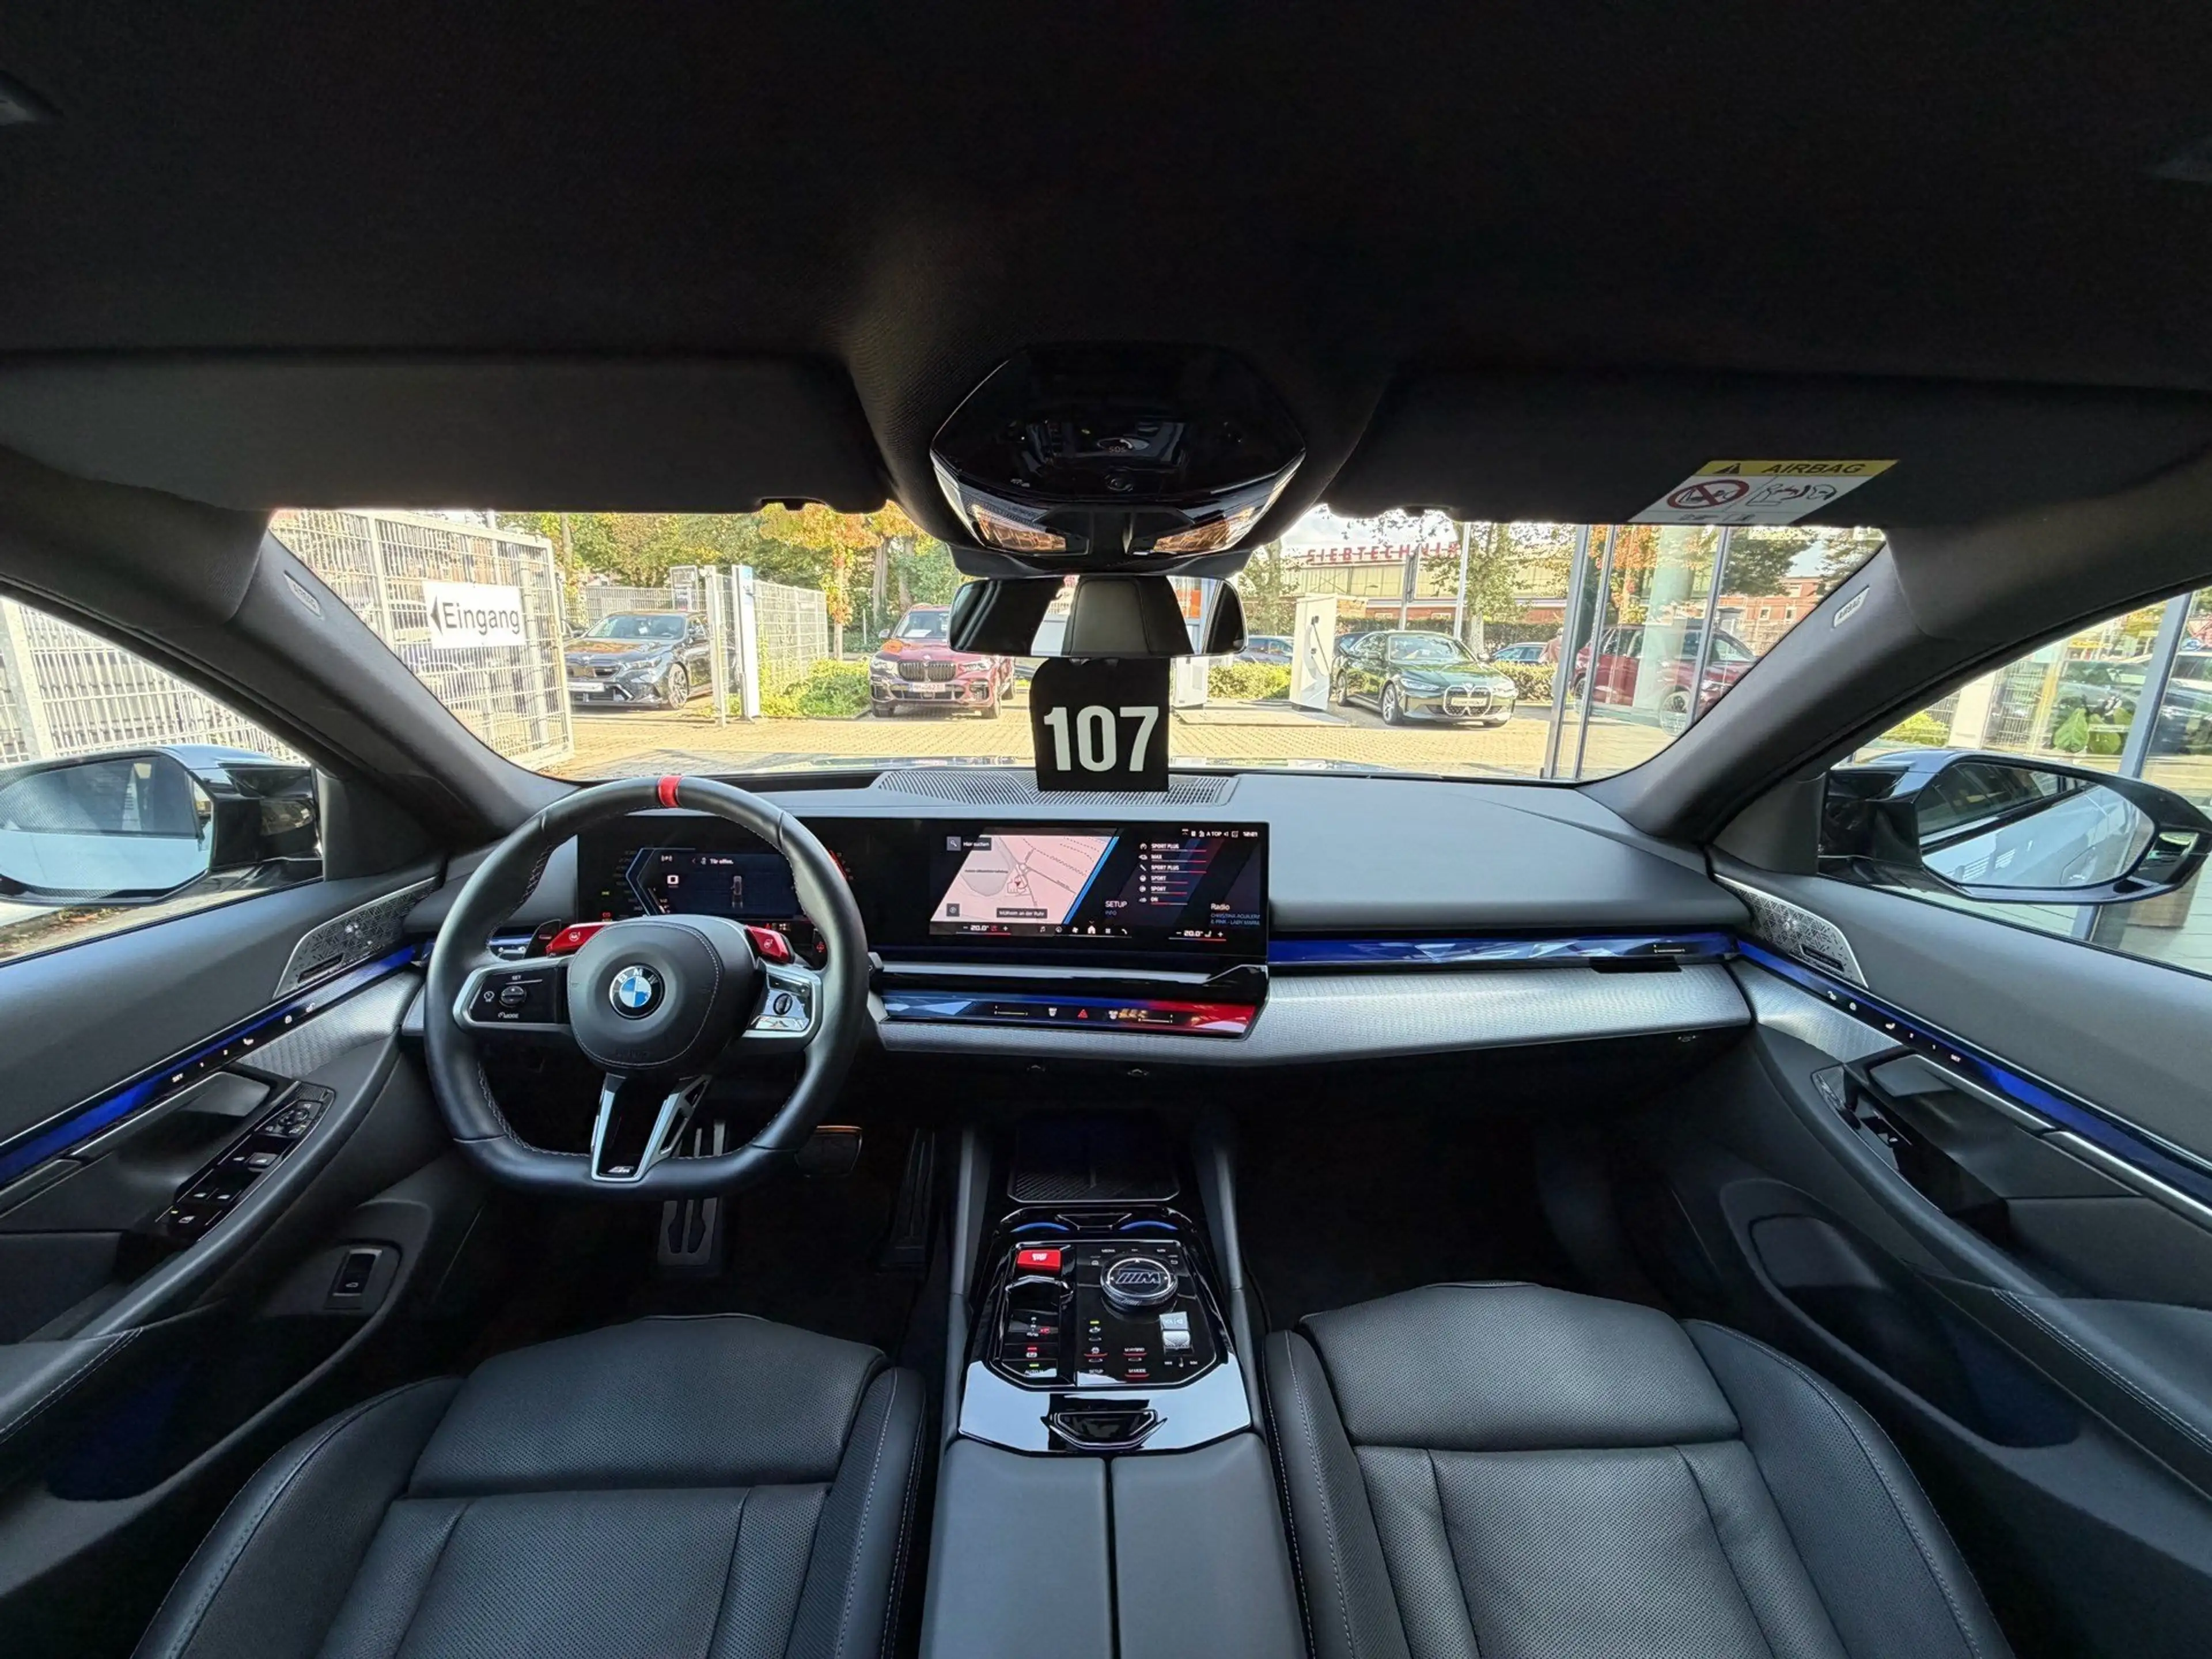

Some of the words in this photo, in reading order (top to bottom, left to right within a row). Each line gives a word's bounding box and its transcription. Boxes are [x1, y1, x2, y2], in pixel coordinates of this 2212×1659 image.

[1761, 463, 1866, 474] AIRBAG
[442, 602, 520, 635] Eingang
[1043, 705, 1159, 773] 107
[618, 968, 658, 985] BMW
